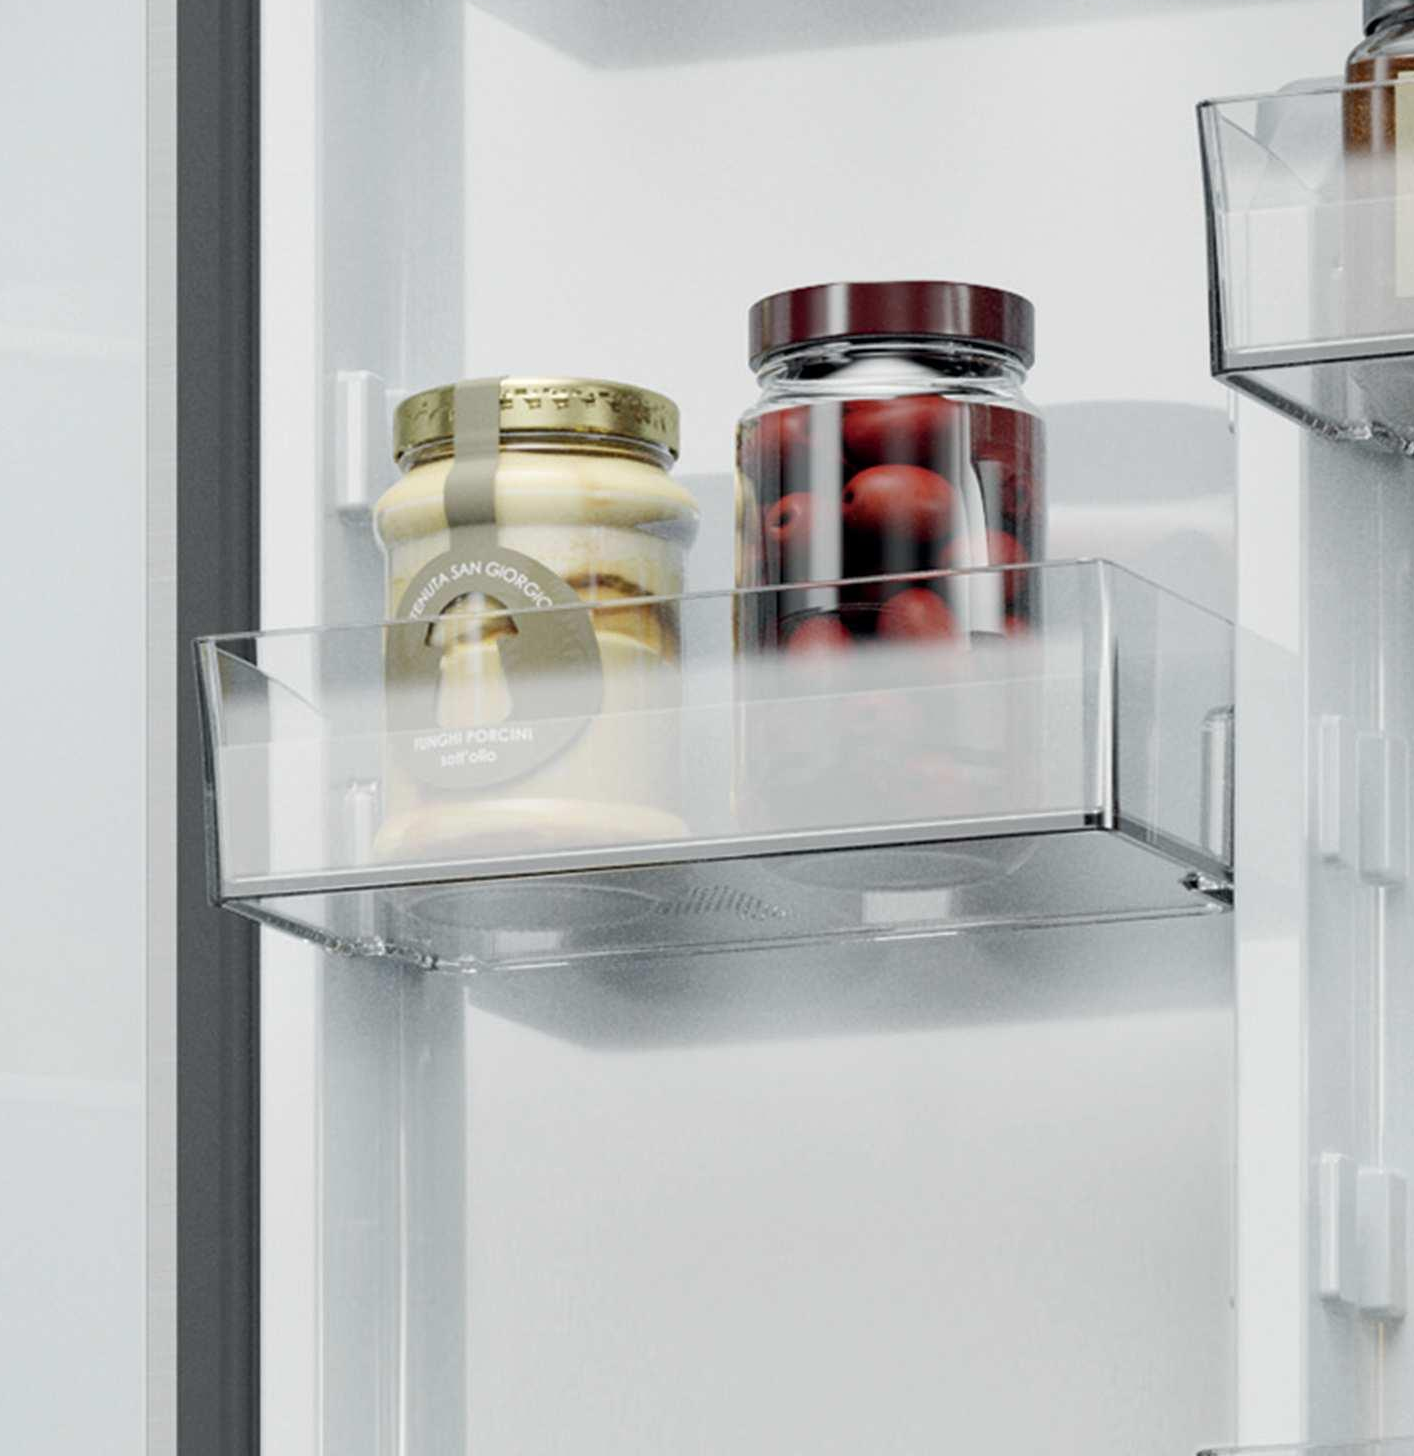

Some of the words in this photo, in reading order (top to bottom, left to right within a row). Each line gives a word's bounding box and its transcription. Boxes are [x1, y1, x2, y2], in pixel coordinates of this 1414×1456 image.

[410, 572, 450, 620] TENUTA
[450, 560, 482, 581] SAN
[485, 560, 553, 609] GIORGIO
[465, 727, 534, 744] PORCINI
